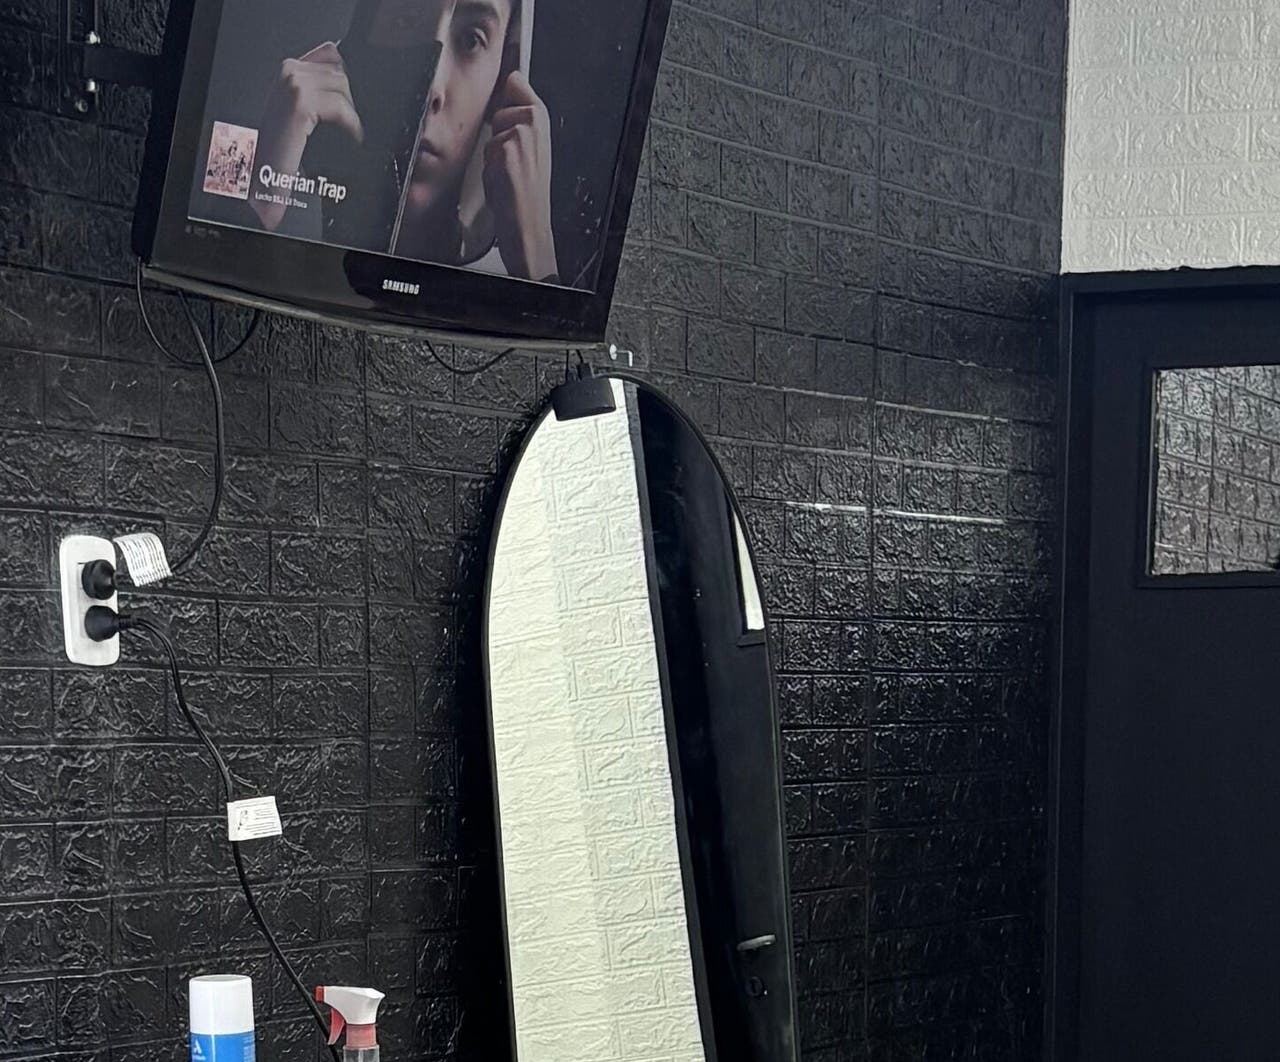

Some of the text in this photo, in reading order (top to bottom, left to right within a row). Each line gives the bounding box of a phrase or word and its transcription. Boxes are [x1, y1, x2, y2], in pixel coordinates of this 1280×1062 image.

[259, 164, 316, 195] Querian
[317, 175, 347, 204] Trap
[382, 279, 420, 295] SAMSUNG
